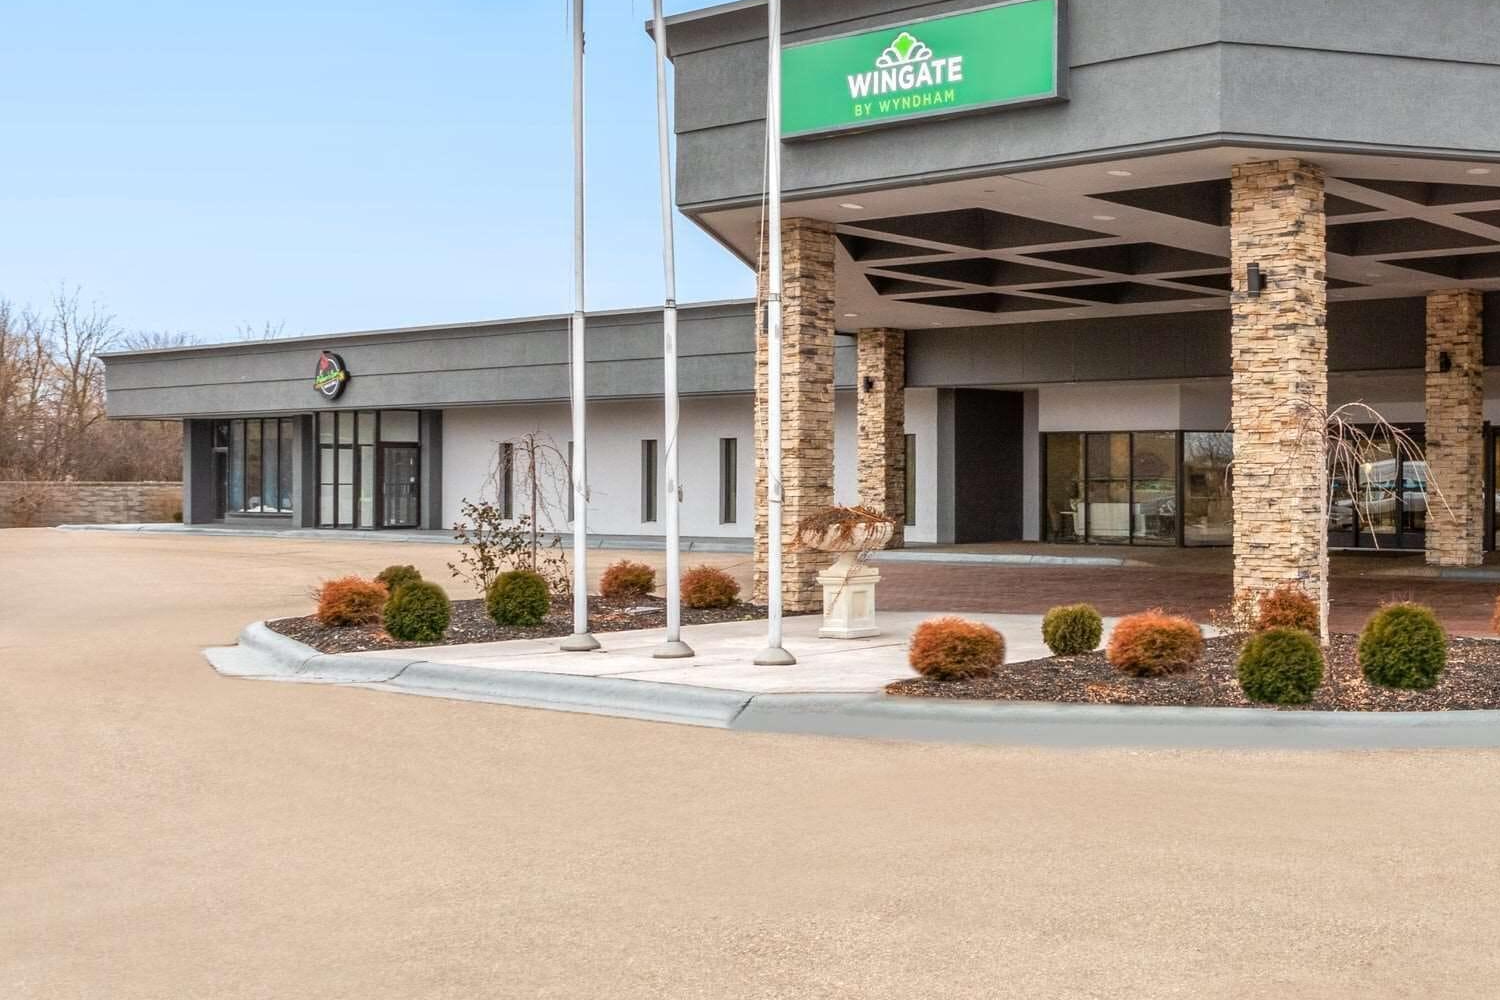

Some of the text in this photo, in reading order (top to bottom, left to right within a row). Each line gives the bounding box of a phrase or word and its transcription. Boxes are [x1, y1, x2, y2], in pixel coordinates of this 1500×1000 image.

[847, 56, 963, 98] WINGATE
[854, 89, 955, 117] BY WYNDHAM
